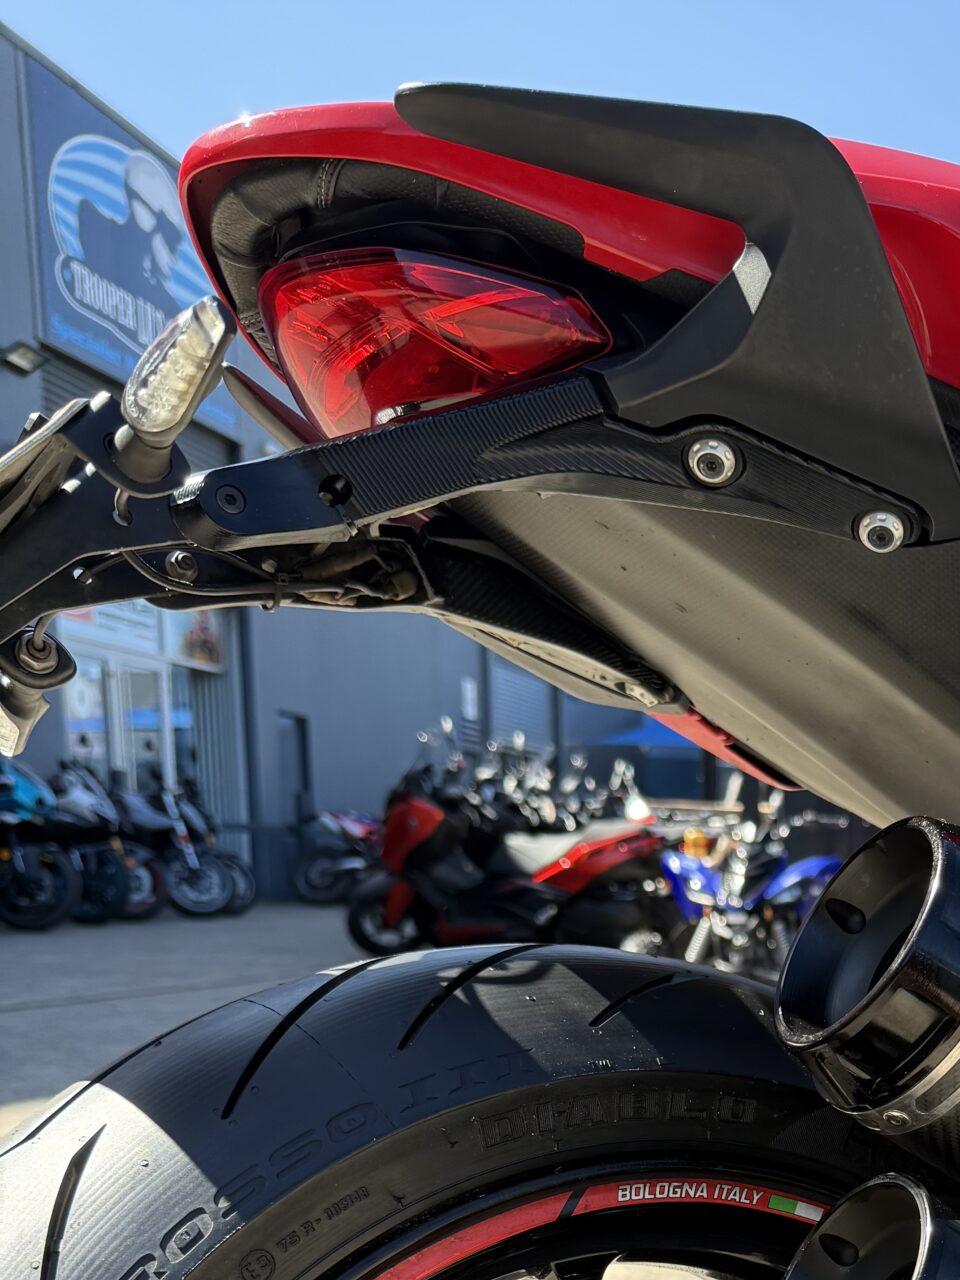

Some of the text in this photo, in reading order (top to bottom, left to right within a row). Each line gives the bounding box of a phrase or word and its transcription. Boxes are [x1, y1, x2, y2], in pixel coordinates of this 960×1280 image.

[69, 260, 137, 332] TROOPER
[476, 1087, 757, 1150] DIABLO
[617, 1181, 764, 1205] BOLOGNA ITALY
